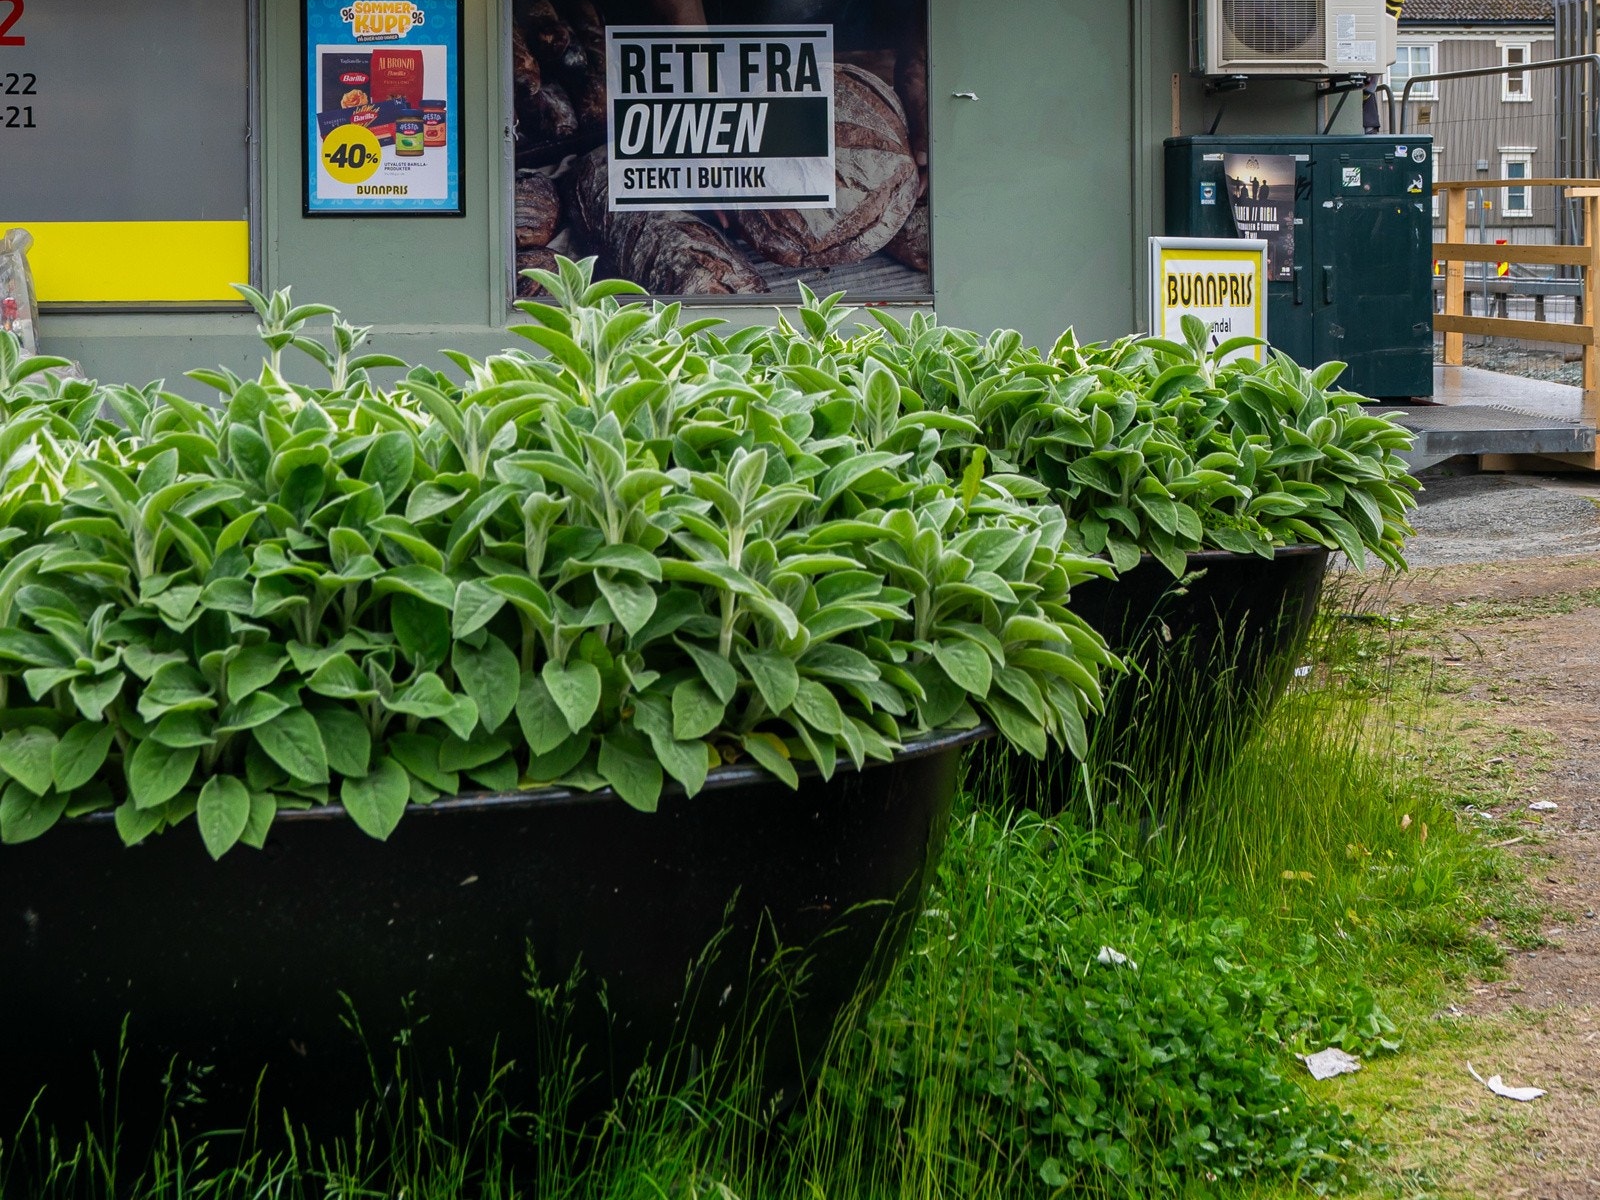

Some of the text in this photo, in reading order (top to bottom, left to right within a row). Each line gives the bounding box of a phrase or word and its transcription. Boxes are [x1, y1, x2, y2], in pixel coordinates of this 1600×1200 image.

[355, 2, 415, 13] SOMMER-
[355, 15, 411, 33] KUPP
[387, 58, 414, 70] BRONZO
[621, 42, 821, 93] RETT FRA
[354, 113, 374, 122] Barilla
[423, 113, 441, 121] PESTO
[620, 102, 768, 154] OVNEN
[325, 144, 378, 168] -40%
[624, 166, 766, 189] STEKT I BUTIKK
[357, 185, 408, 195] BUNNPRIS
[1167, 272, 1252, 308] BUNNPRIS
